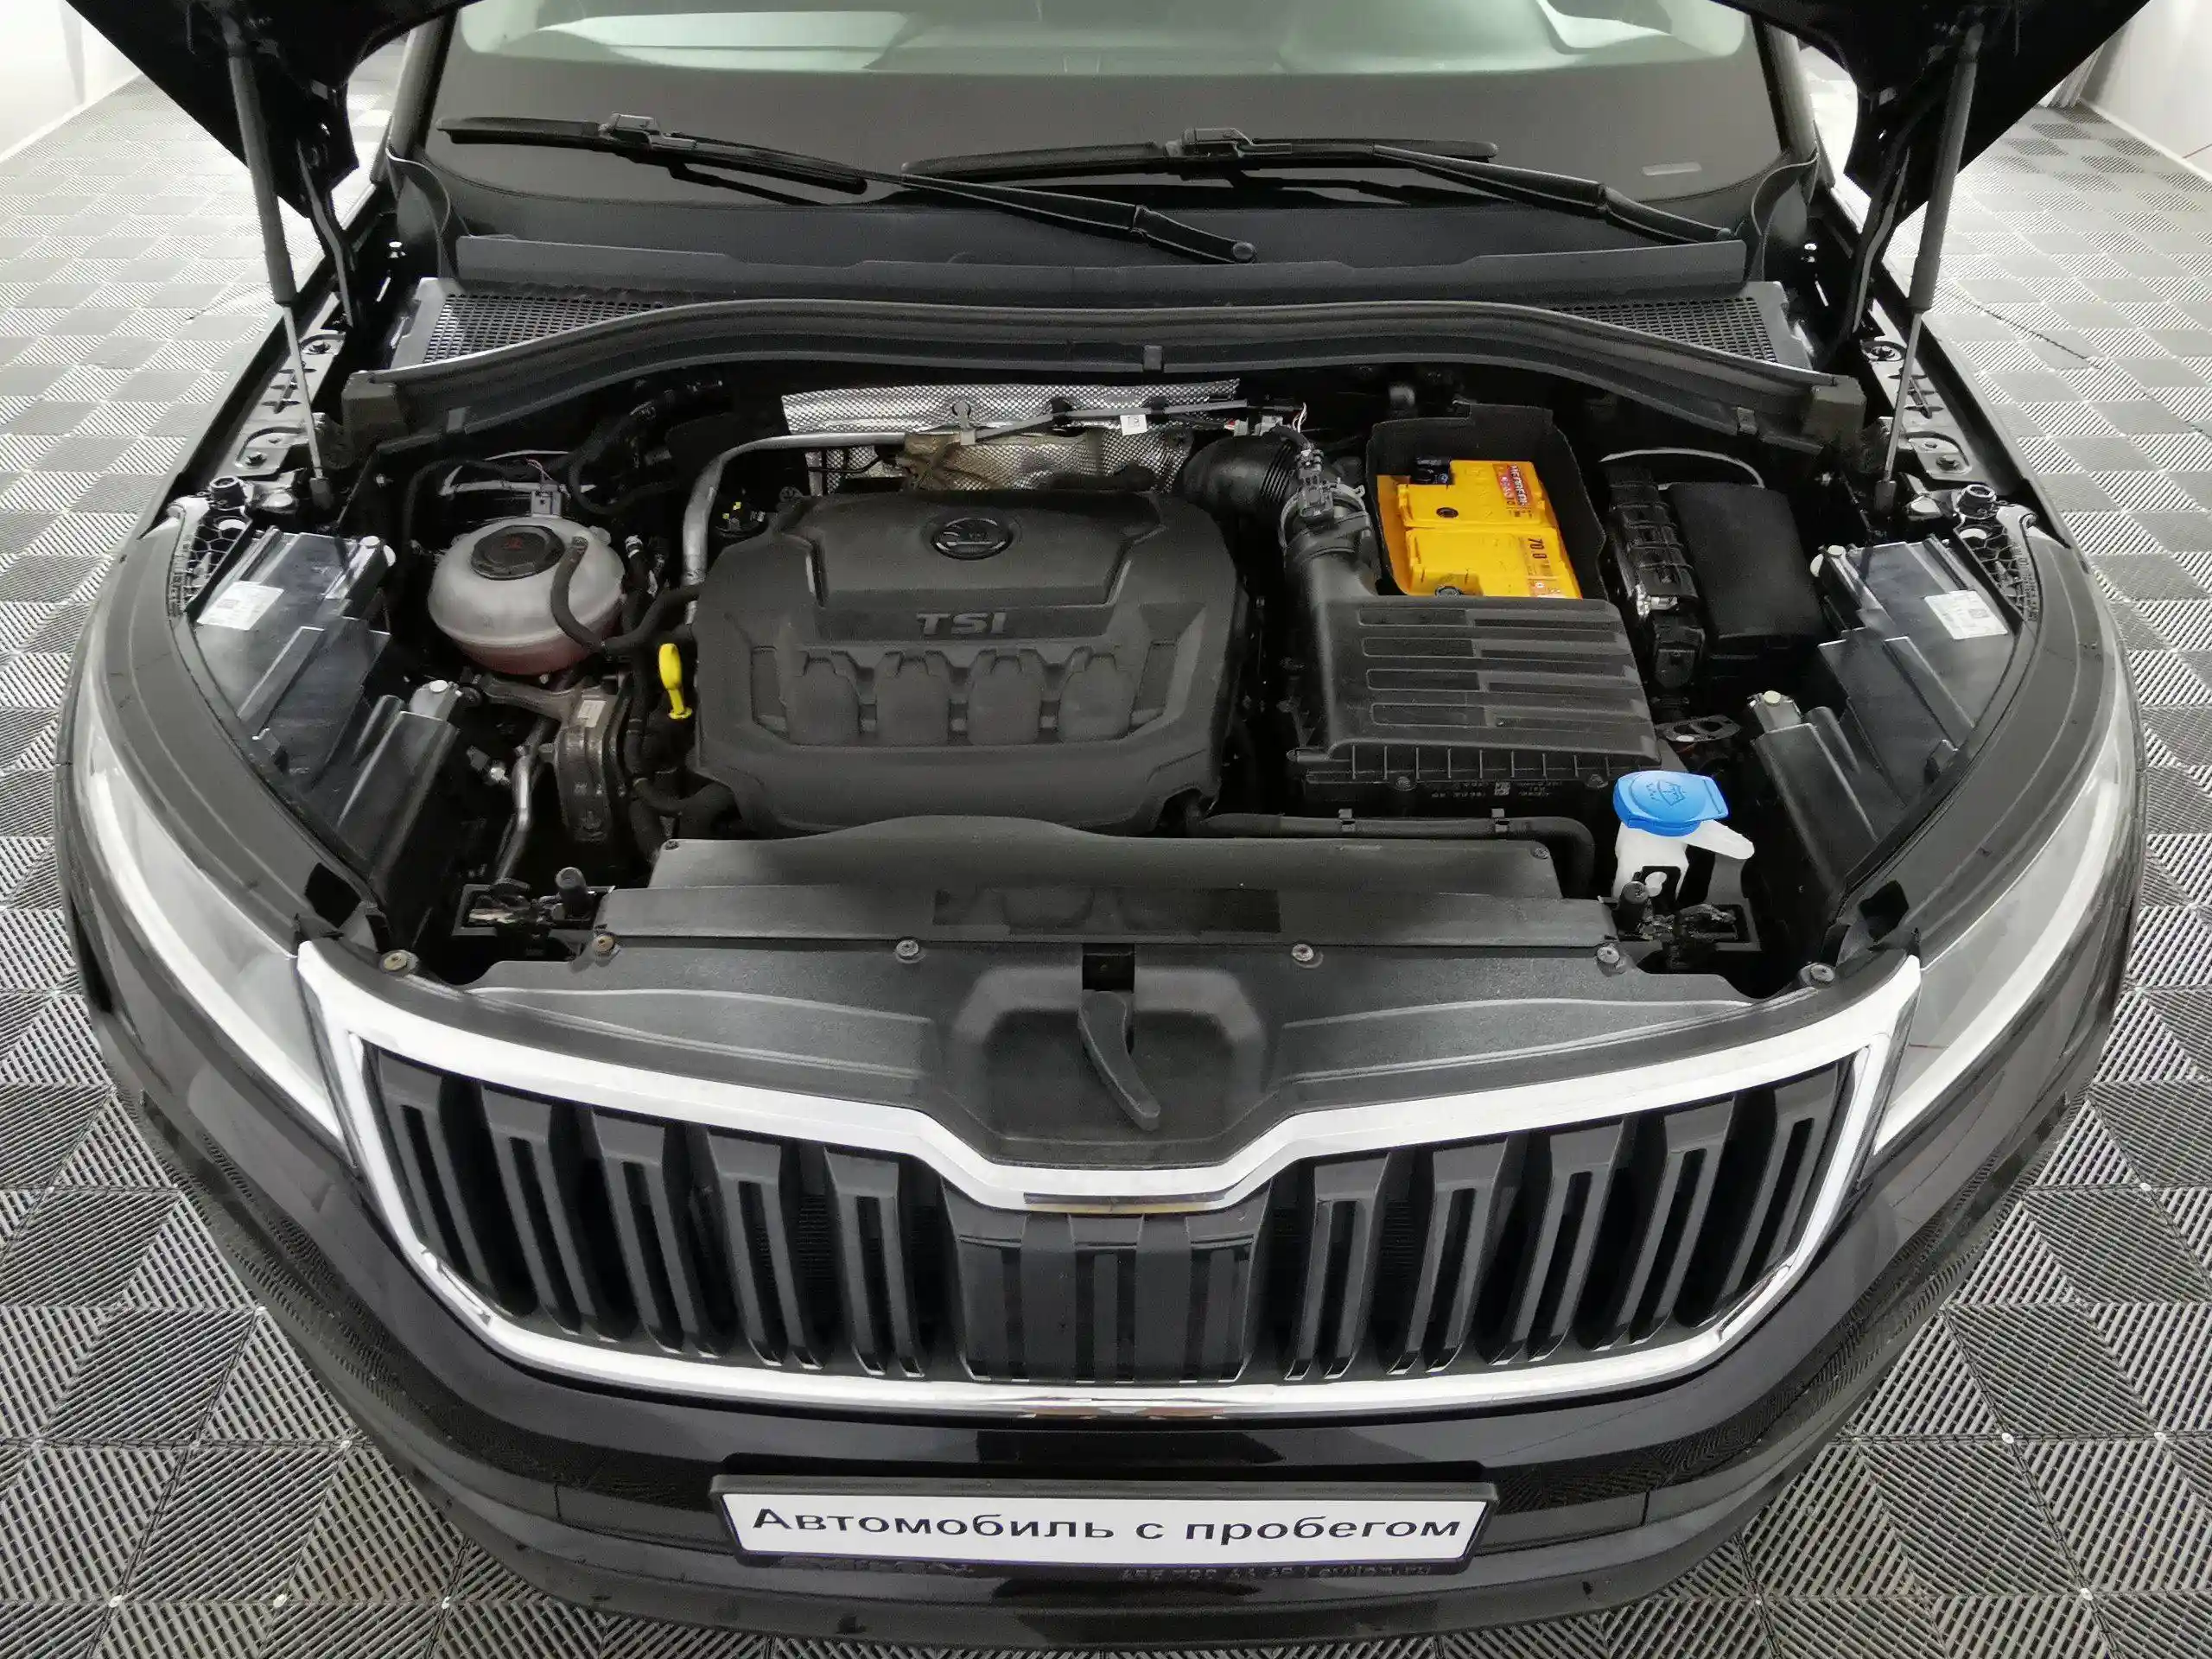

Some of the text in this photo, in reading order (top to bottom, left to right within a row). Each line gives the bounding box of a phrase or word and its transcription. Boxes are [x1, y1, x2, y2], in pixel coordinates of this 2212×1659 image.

[916, 612, 1007, 635] TSI
[753, 1508, 1461, 1545] Автомобиль с пробегом
